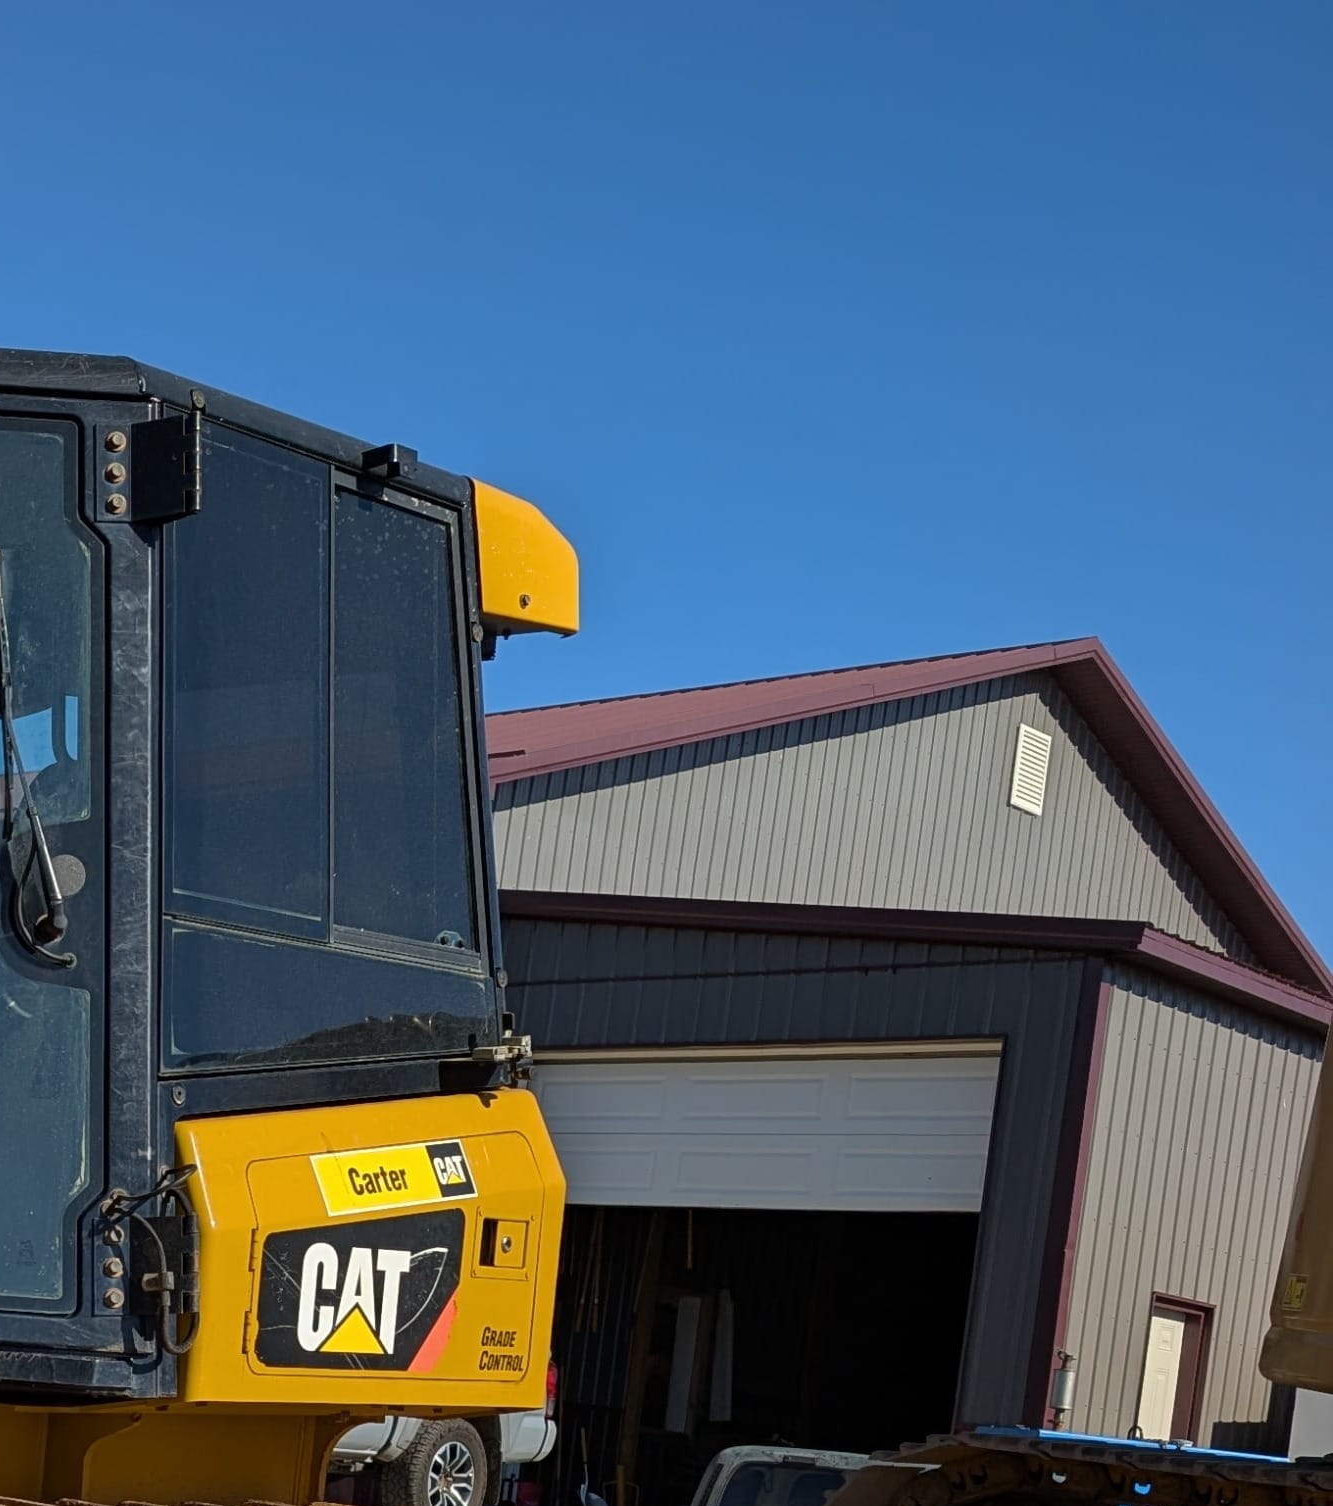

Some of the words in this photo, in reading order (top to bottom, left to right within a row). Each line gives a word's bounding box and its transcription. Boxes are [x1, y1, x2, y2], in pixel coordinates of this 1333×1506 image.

[347, 1166, 409, 1196] Carter
[433, 1154, 467, 1186] CAT
[297, 1242, 411, 1355] CAT
[481, 1326, 517, 1348] GRADE
[479, 1350, 524, 1372] CONTROL
